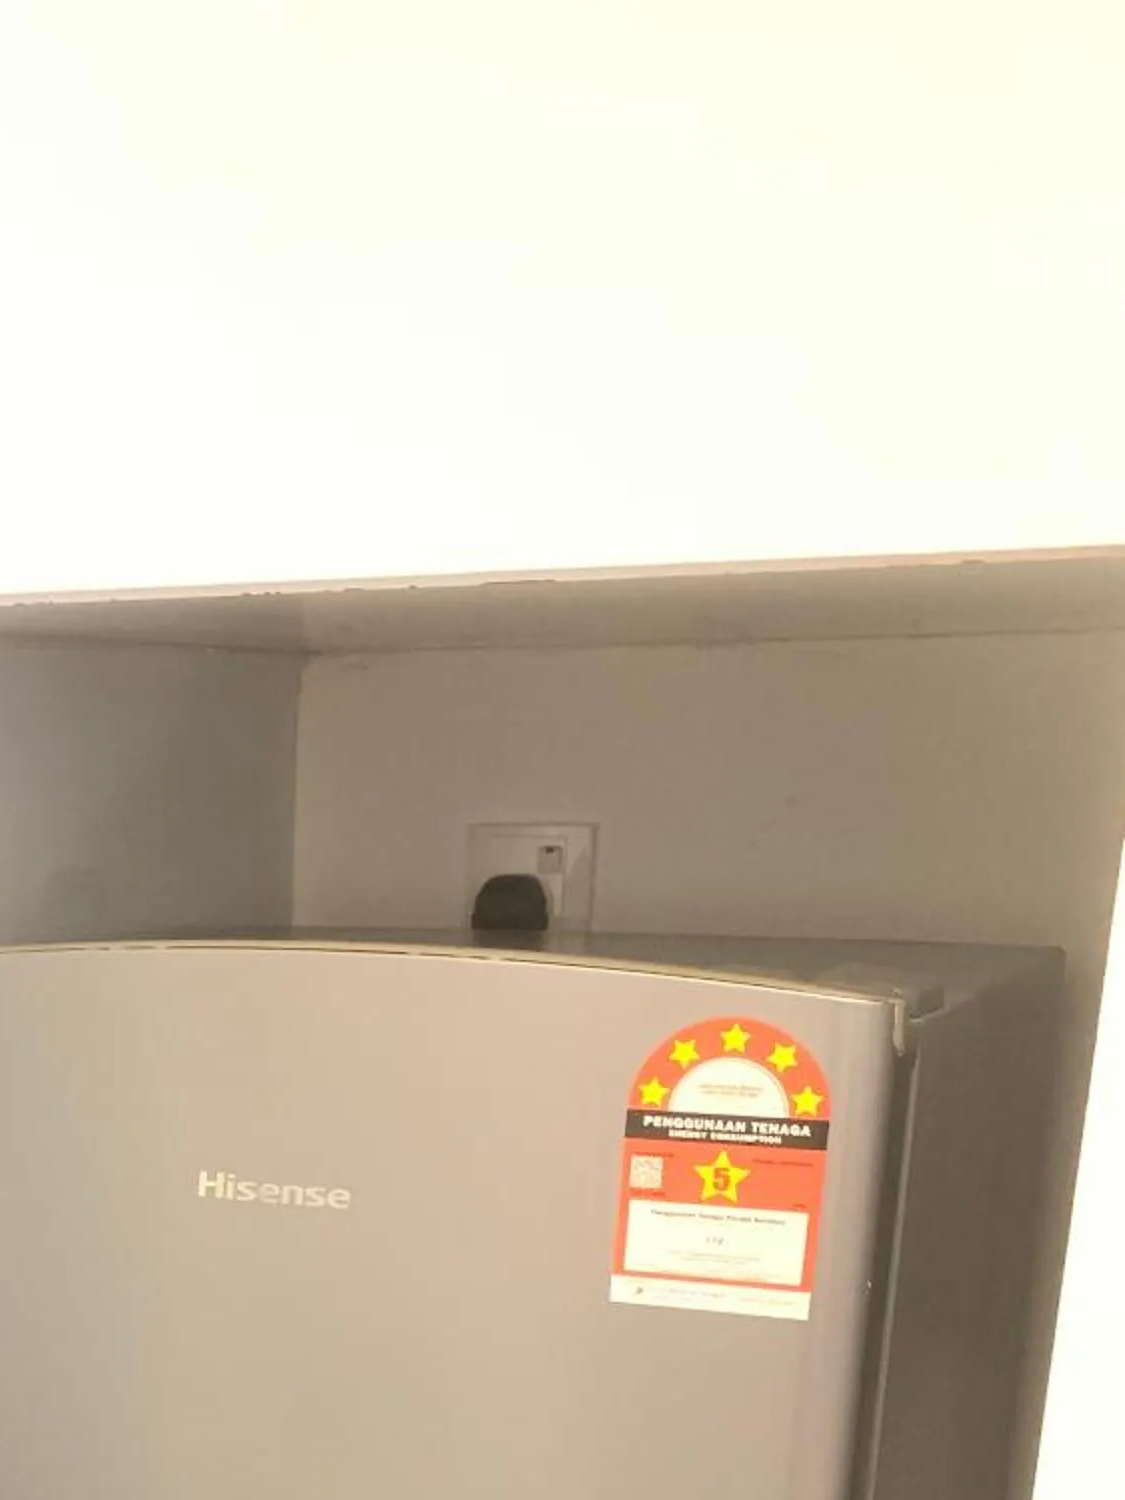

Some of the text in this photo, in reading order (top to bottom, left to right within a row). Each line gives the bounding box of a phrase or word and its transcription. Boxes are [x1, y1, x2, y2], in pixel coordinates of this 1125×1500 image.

[642, 1114, 811, 1138] PENGGUNAAN TENAGA
[197, 1168, 351, 1210] Hisense
[712, 1167, 731, 1191] 5
